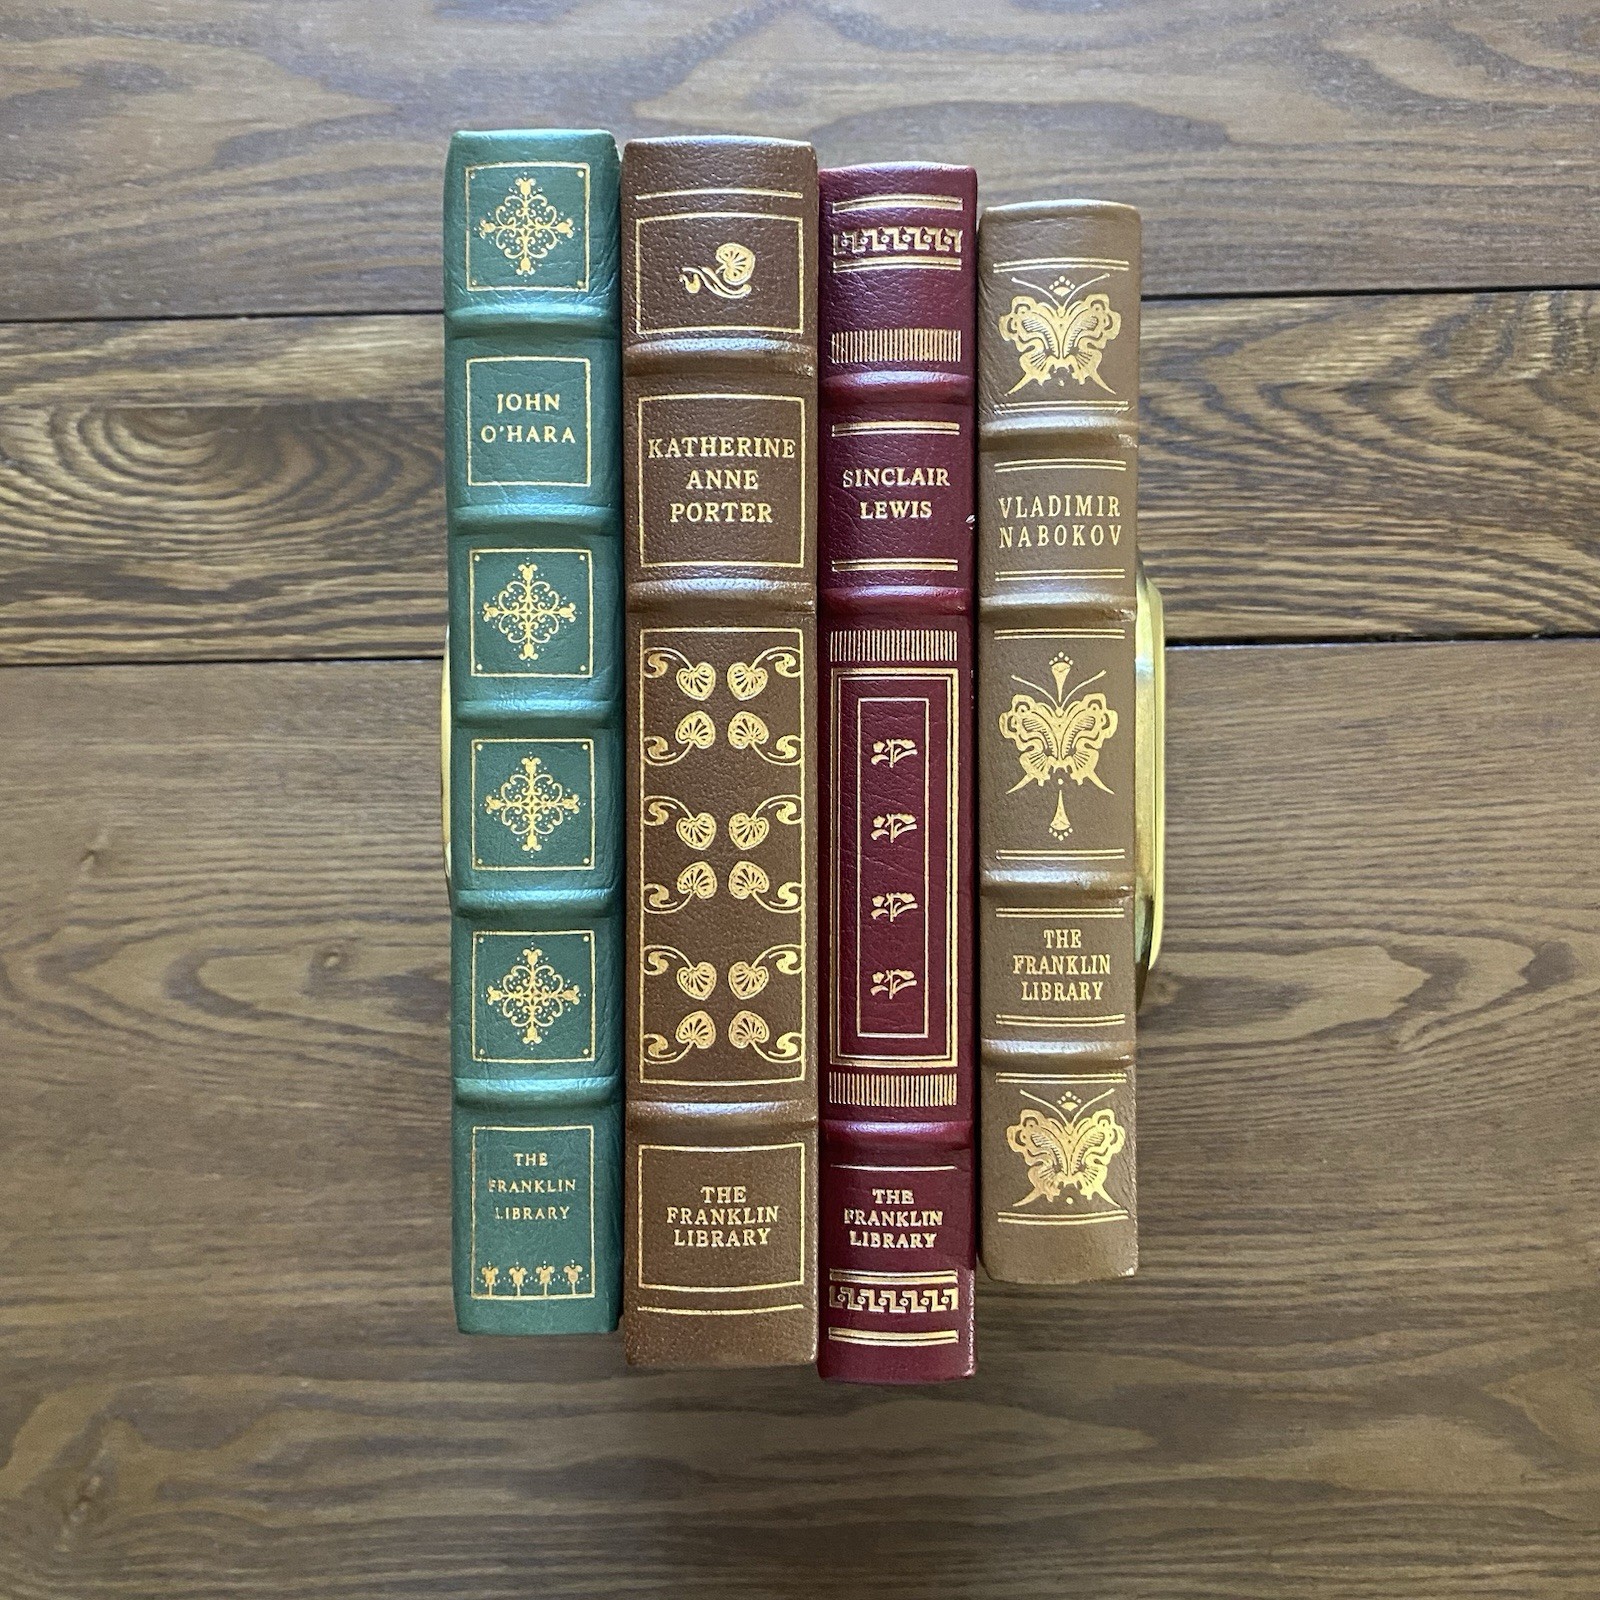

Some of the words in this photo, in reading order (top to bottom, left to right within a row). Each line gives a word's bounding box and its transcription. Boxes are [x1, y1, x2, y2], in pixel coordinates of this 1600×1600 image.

[497, 393, 560, 414] JOHN
[481, 425, 576, 443] O'HARA
[648, 437, 796, 459] KATHERINE
[685, 470, 759, 490] ANNE
[842, 467, 950, 487] SINCLAIR
[669, 503, 773, 523] PORTER
[860, 501, 932, 519] LEWIS
[998, 495, 1121, 518] VLADIMIR
[999, 524, 1122, 548] NABOKOV
[1043, 929, 1082, 948] THE
[1013, 954, 1111, 975] FRANKLIN
[1021, 982, 1104, 1001] LIBRARY
[513, 1153, 548, 1166] THE
[488, 1179, 576, 1193] FRANKLIN
[700, 1186, 747, 1203] THE
[872, 1189, 914, 1204] THE
[495, 1206, 570, 1220] LIBRARY
[666, 1206, 779, 1225] FRANKLIN
[844, 1209, 943, 1225] FRANKLIN
[673, 1228, 771, 1248] LIBRARY
[850, 1232, 937, 1248] LIBRARY
